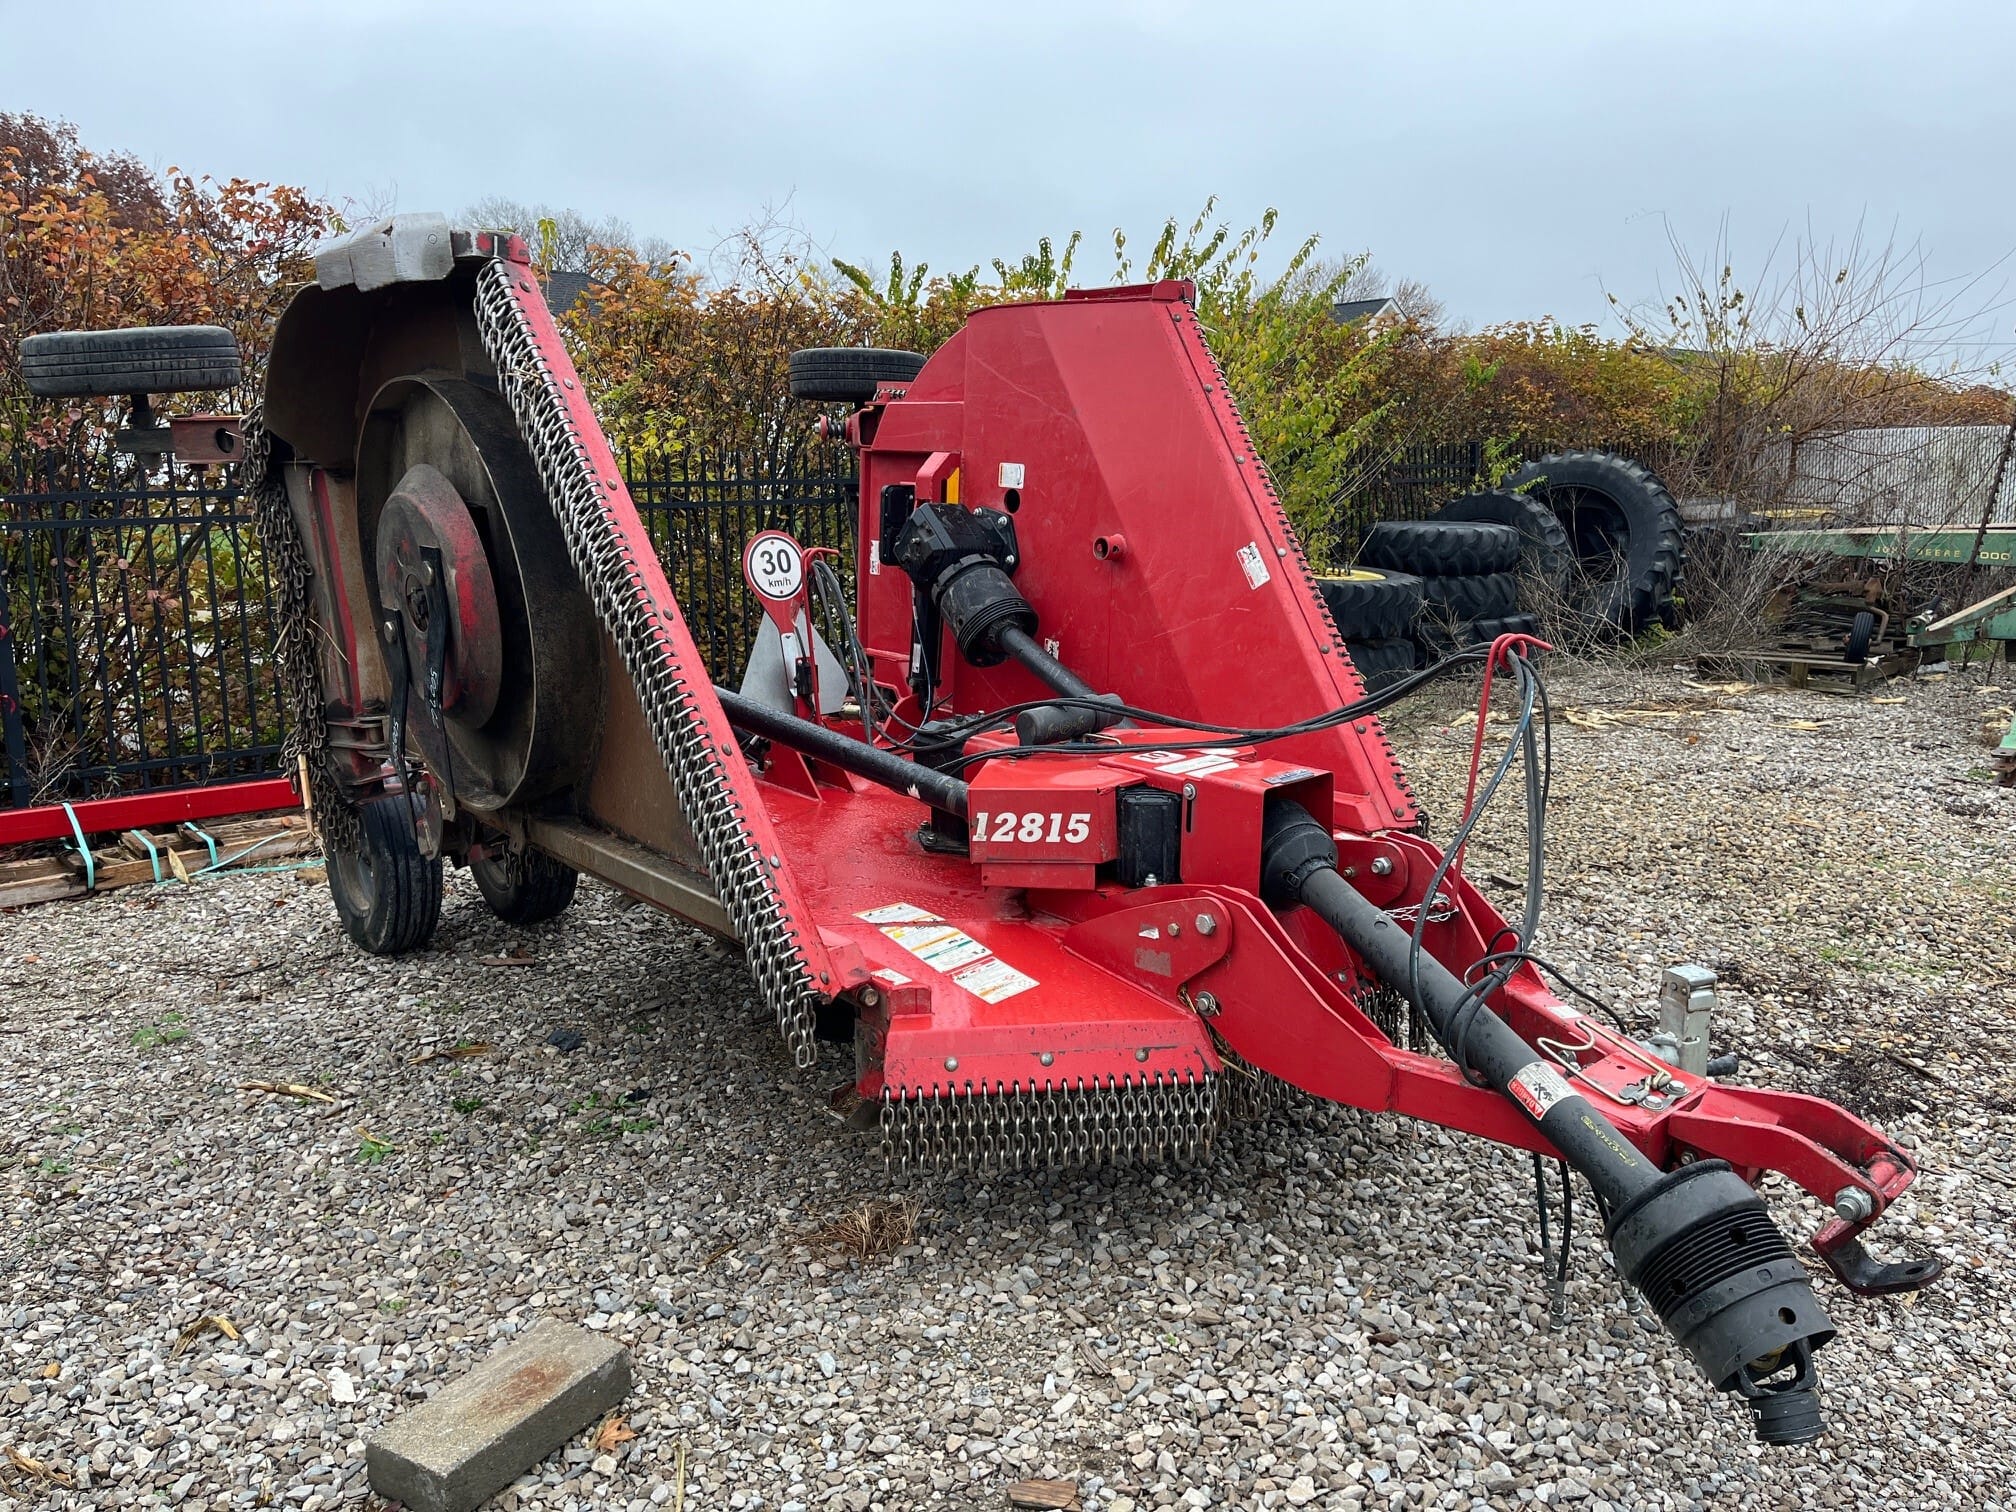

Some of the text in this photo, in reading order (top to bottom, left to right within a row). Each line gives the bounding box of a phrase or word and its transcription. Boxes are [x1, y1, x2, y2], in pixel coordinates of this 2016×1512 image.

[760, 549, 791, 575] 30
[768, 577, 791, 587] km/h
[972, 812, 1091, 843] 12815
[1510, 1081, 1535, 1108] DANGER
